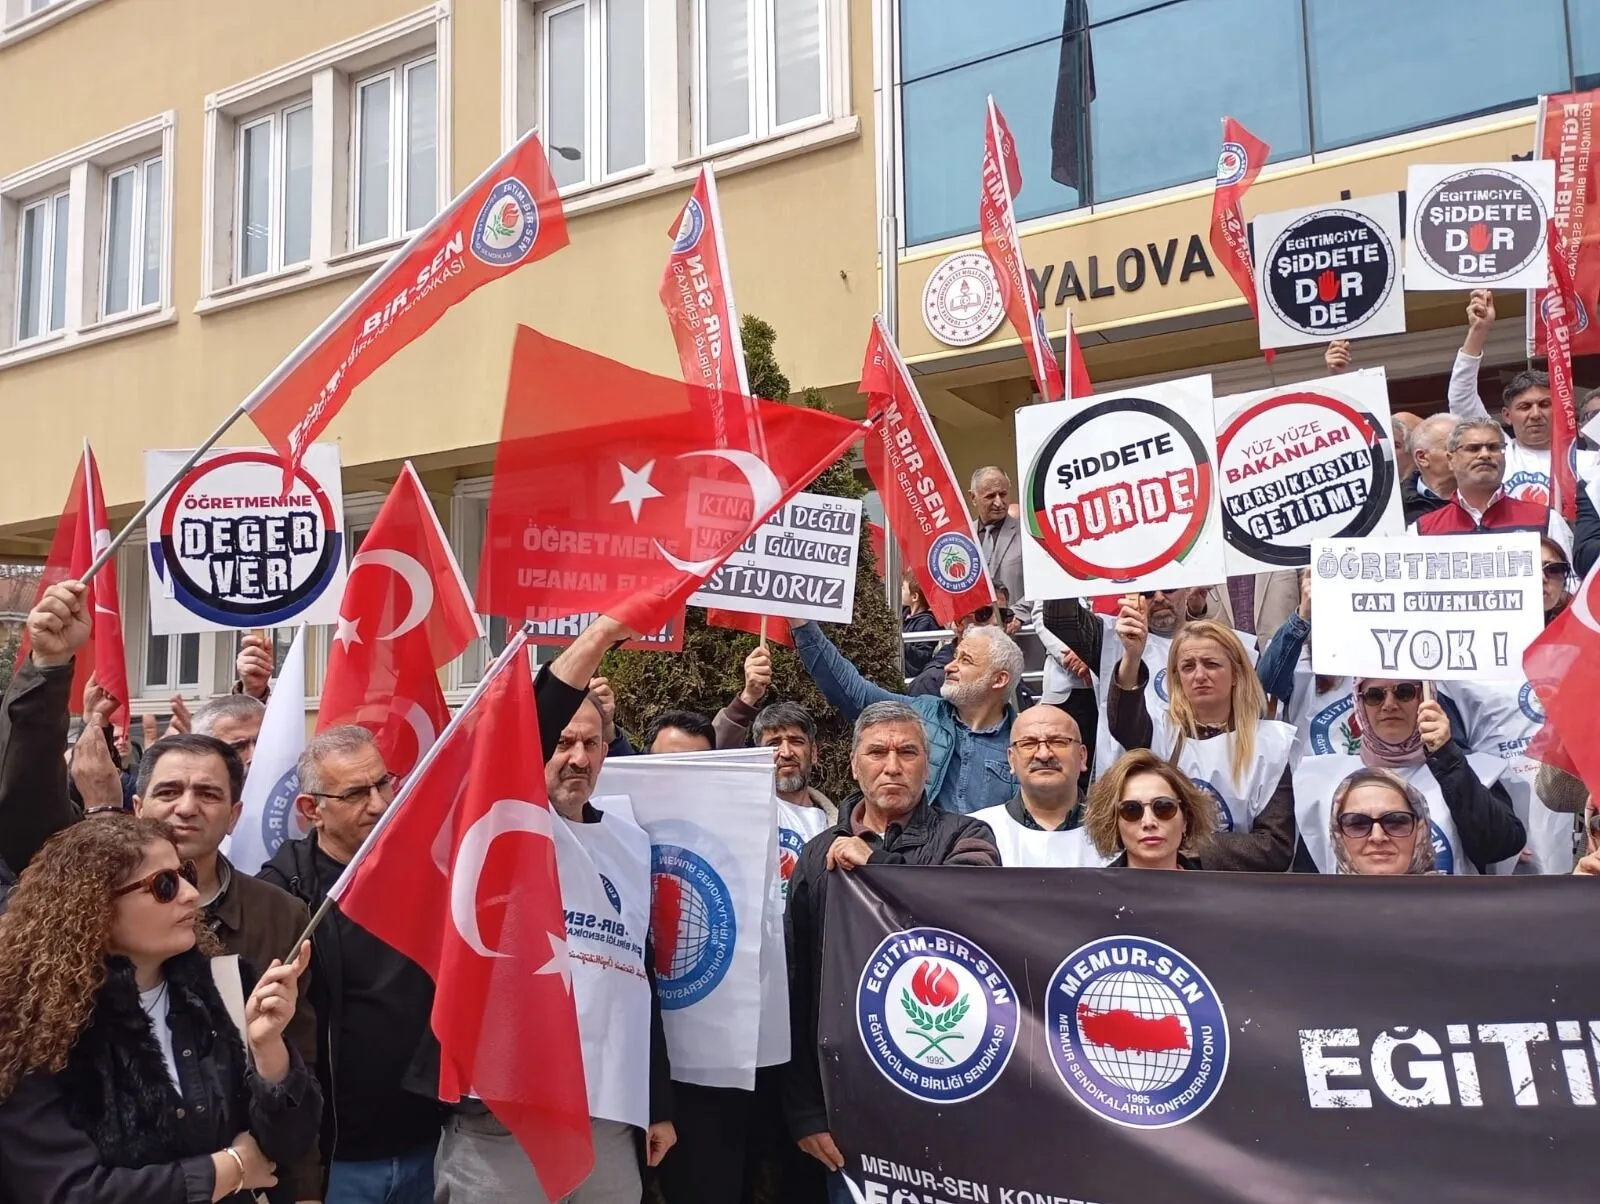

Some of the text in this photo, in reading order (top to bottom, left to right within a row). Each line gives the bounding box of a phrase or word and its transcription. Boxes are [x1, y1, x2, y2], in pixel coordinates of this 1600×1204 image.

[1028, 234, 1215, 309] YALOVA
[1458, 253, 1496, 274] DE
[1310, 302, 1348, 326] DE
[1226, 426, 1351, 484] BAKANLARI
[1241, 420, 1321, 459] YÜZ YÜZE
[1057, 432, 1173, 489] ŞİDDETE
[184, 494, 312, 509] ÖĞRETMENİNE
[795, 503, 851, 532] DEĞİL
[1250, 481, 1367, 538] GETİRME
[768, 531, 848, 565] GÜVENCE
[212, 558, 288, 594] VER
[1353, 594, 1393, 611] CAN
[1370, 628, 1477, 670] YOK
[1059, 947, 1204, 1004] MEMUR-SEN
[868, 1013, 1006, 1091] EĞİTİMCİLER BİRLİĞİ SENDİKASI
[926, 1055, 945, 1066] 1992
[1059, 1013, 1075, 1062] MEMUR
[1146, 1025, 1214, 1116] KONFEDERASYONU
[1298, 1021, 1600, 1108] EĞİTİ
[1126, 1093, 1150, 1104] 1995
[861, 1153, 989, 1204] MEMUR-SEN
